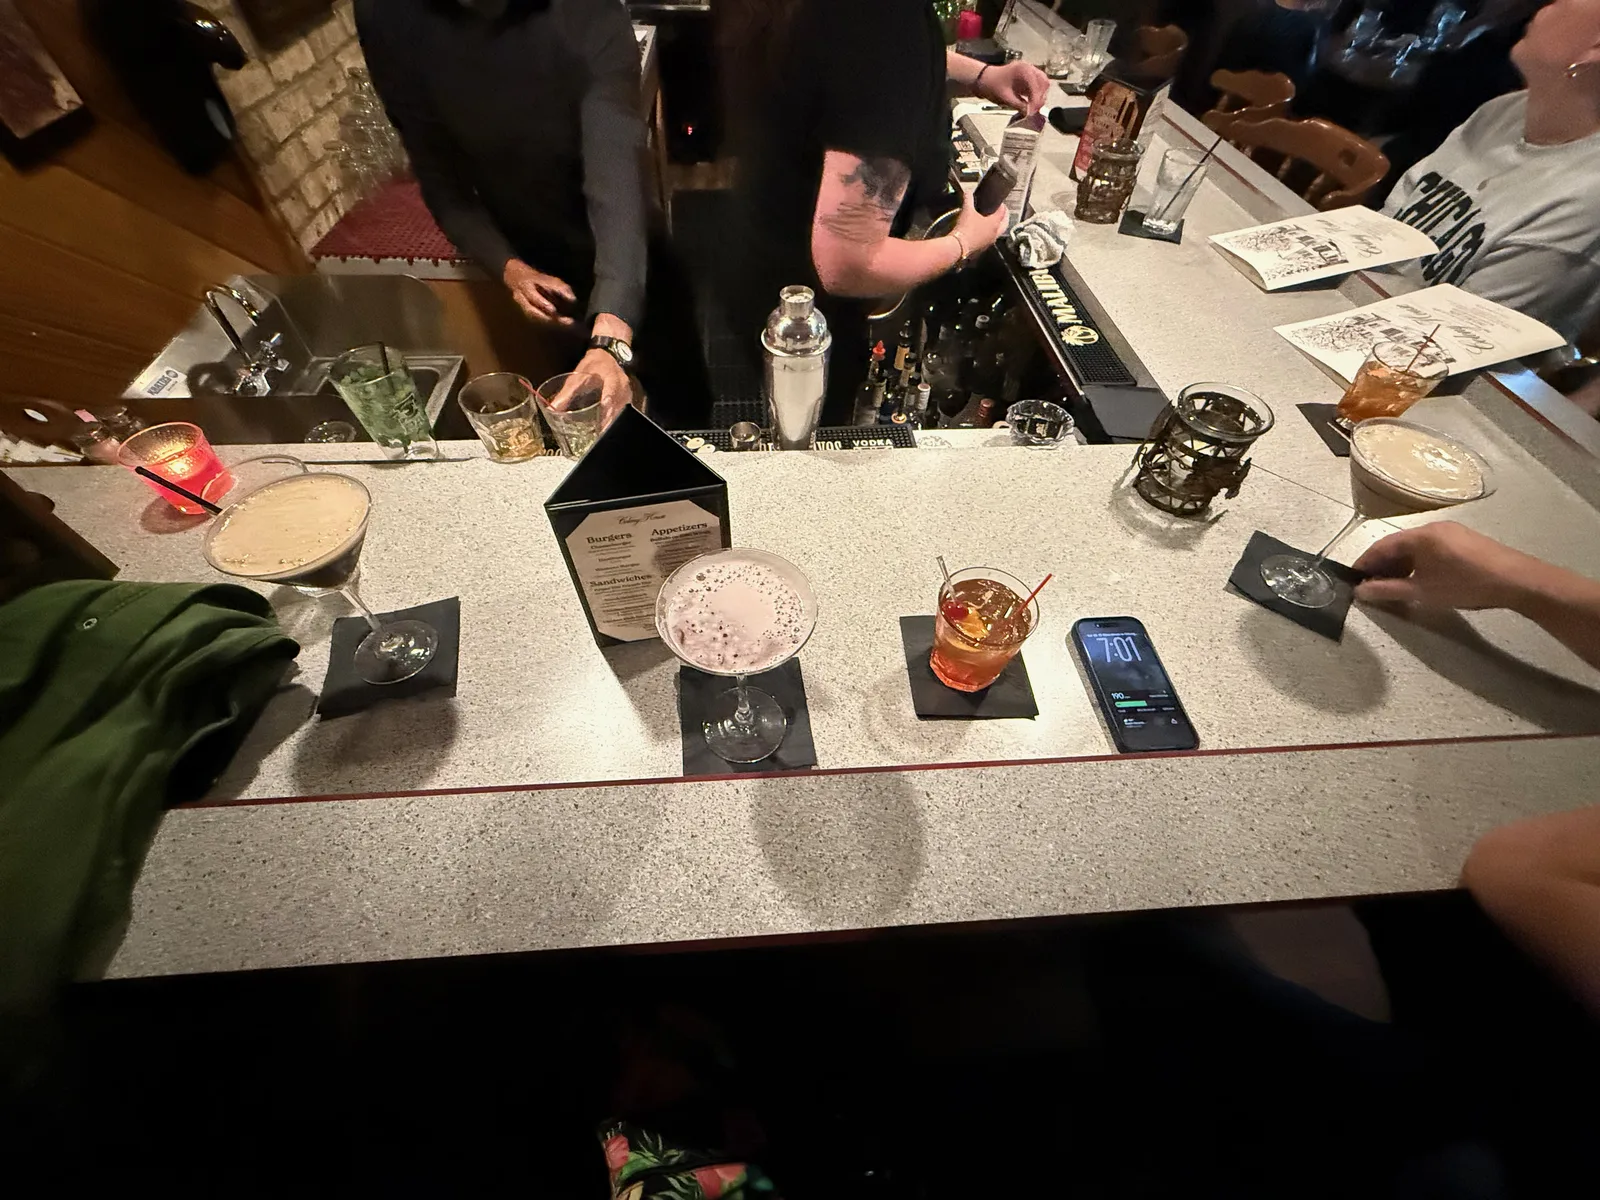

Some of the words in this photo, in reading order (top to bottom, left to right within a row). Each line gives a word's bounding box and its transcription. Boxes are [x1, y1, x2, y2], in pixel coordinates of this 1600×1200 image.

[852, 438, 893, 447] VODKA
[651, 522, 708, 537] Appetizers
[586, 532, 633, 545] Burgers
[589, 574, 653, 588] Sandwiches
[1096, 636, 1142, 663] 7:01
